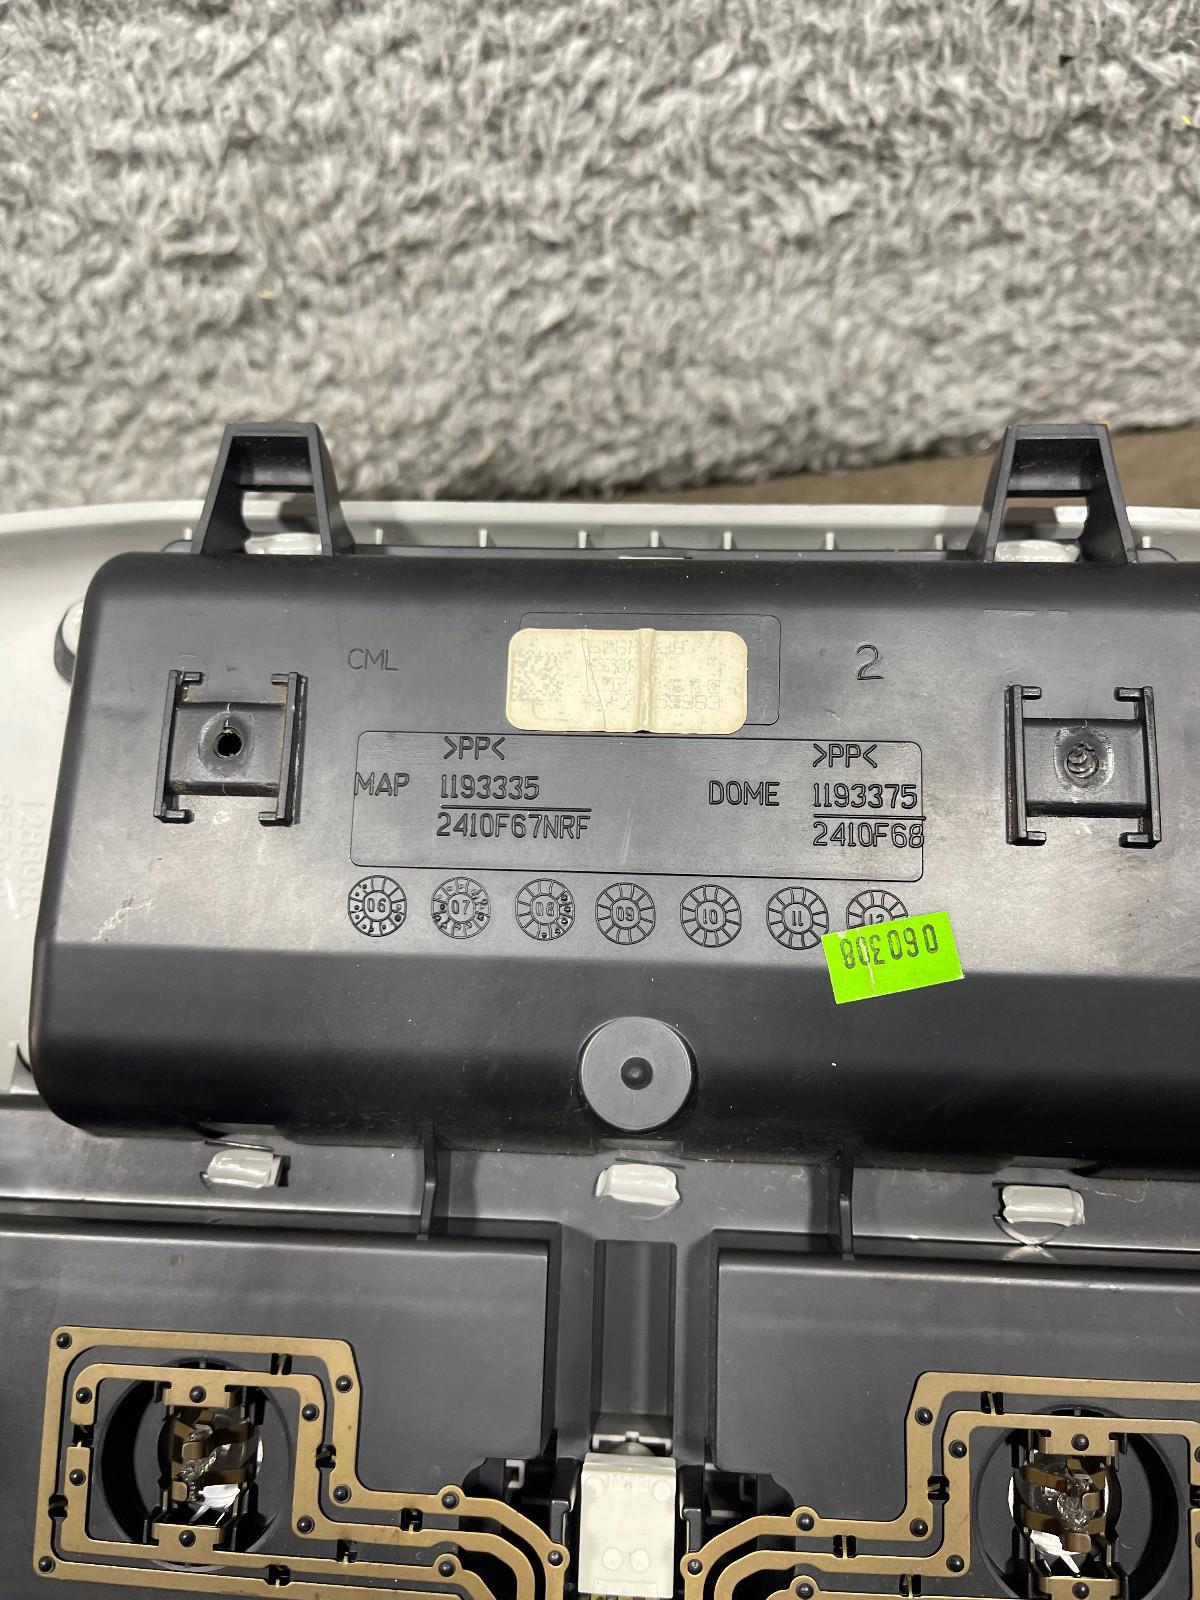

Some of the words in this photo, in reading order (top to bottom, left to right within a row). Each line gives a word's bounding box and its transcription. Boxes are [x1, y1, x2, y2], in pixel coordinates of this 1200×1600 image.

[347, 648, 399, 671] CML
[856, 644, 884, 681] 2
[443, 736, 505, 760] >PP<
[813, 743, 877, 768] >PP<
[353, 772, 410, 797] MAP
[440, 774, 540, 800] 1193335
[708, 780, 780, 807] DOME
[813, 783, 918, 809] 1193375
[436, 812, 591, 839] 2410F67NRF
[813, 821, 925, 848] 2410F68
[367, 896, 387, 913] 06
[451, 899, 471, 915] 07
[615, 905, 634, 922] 09
[702, 908, 718, 925] 10
[791, 910, 804, 927] 11
[839, 924, 939, 970] 060308
